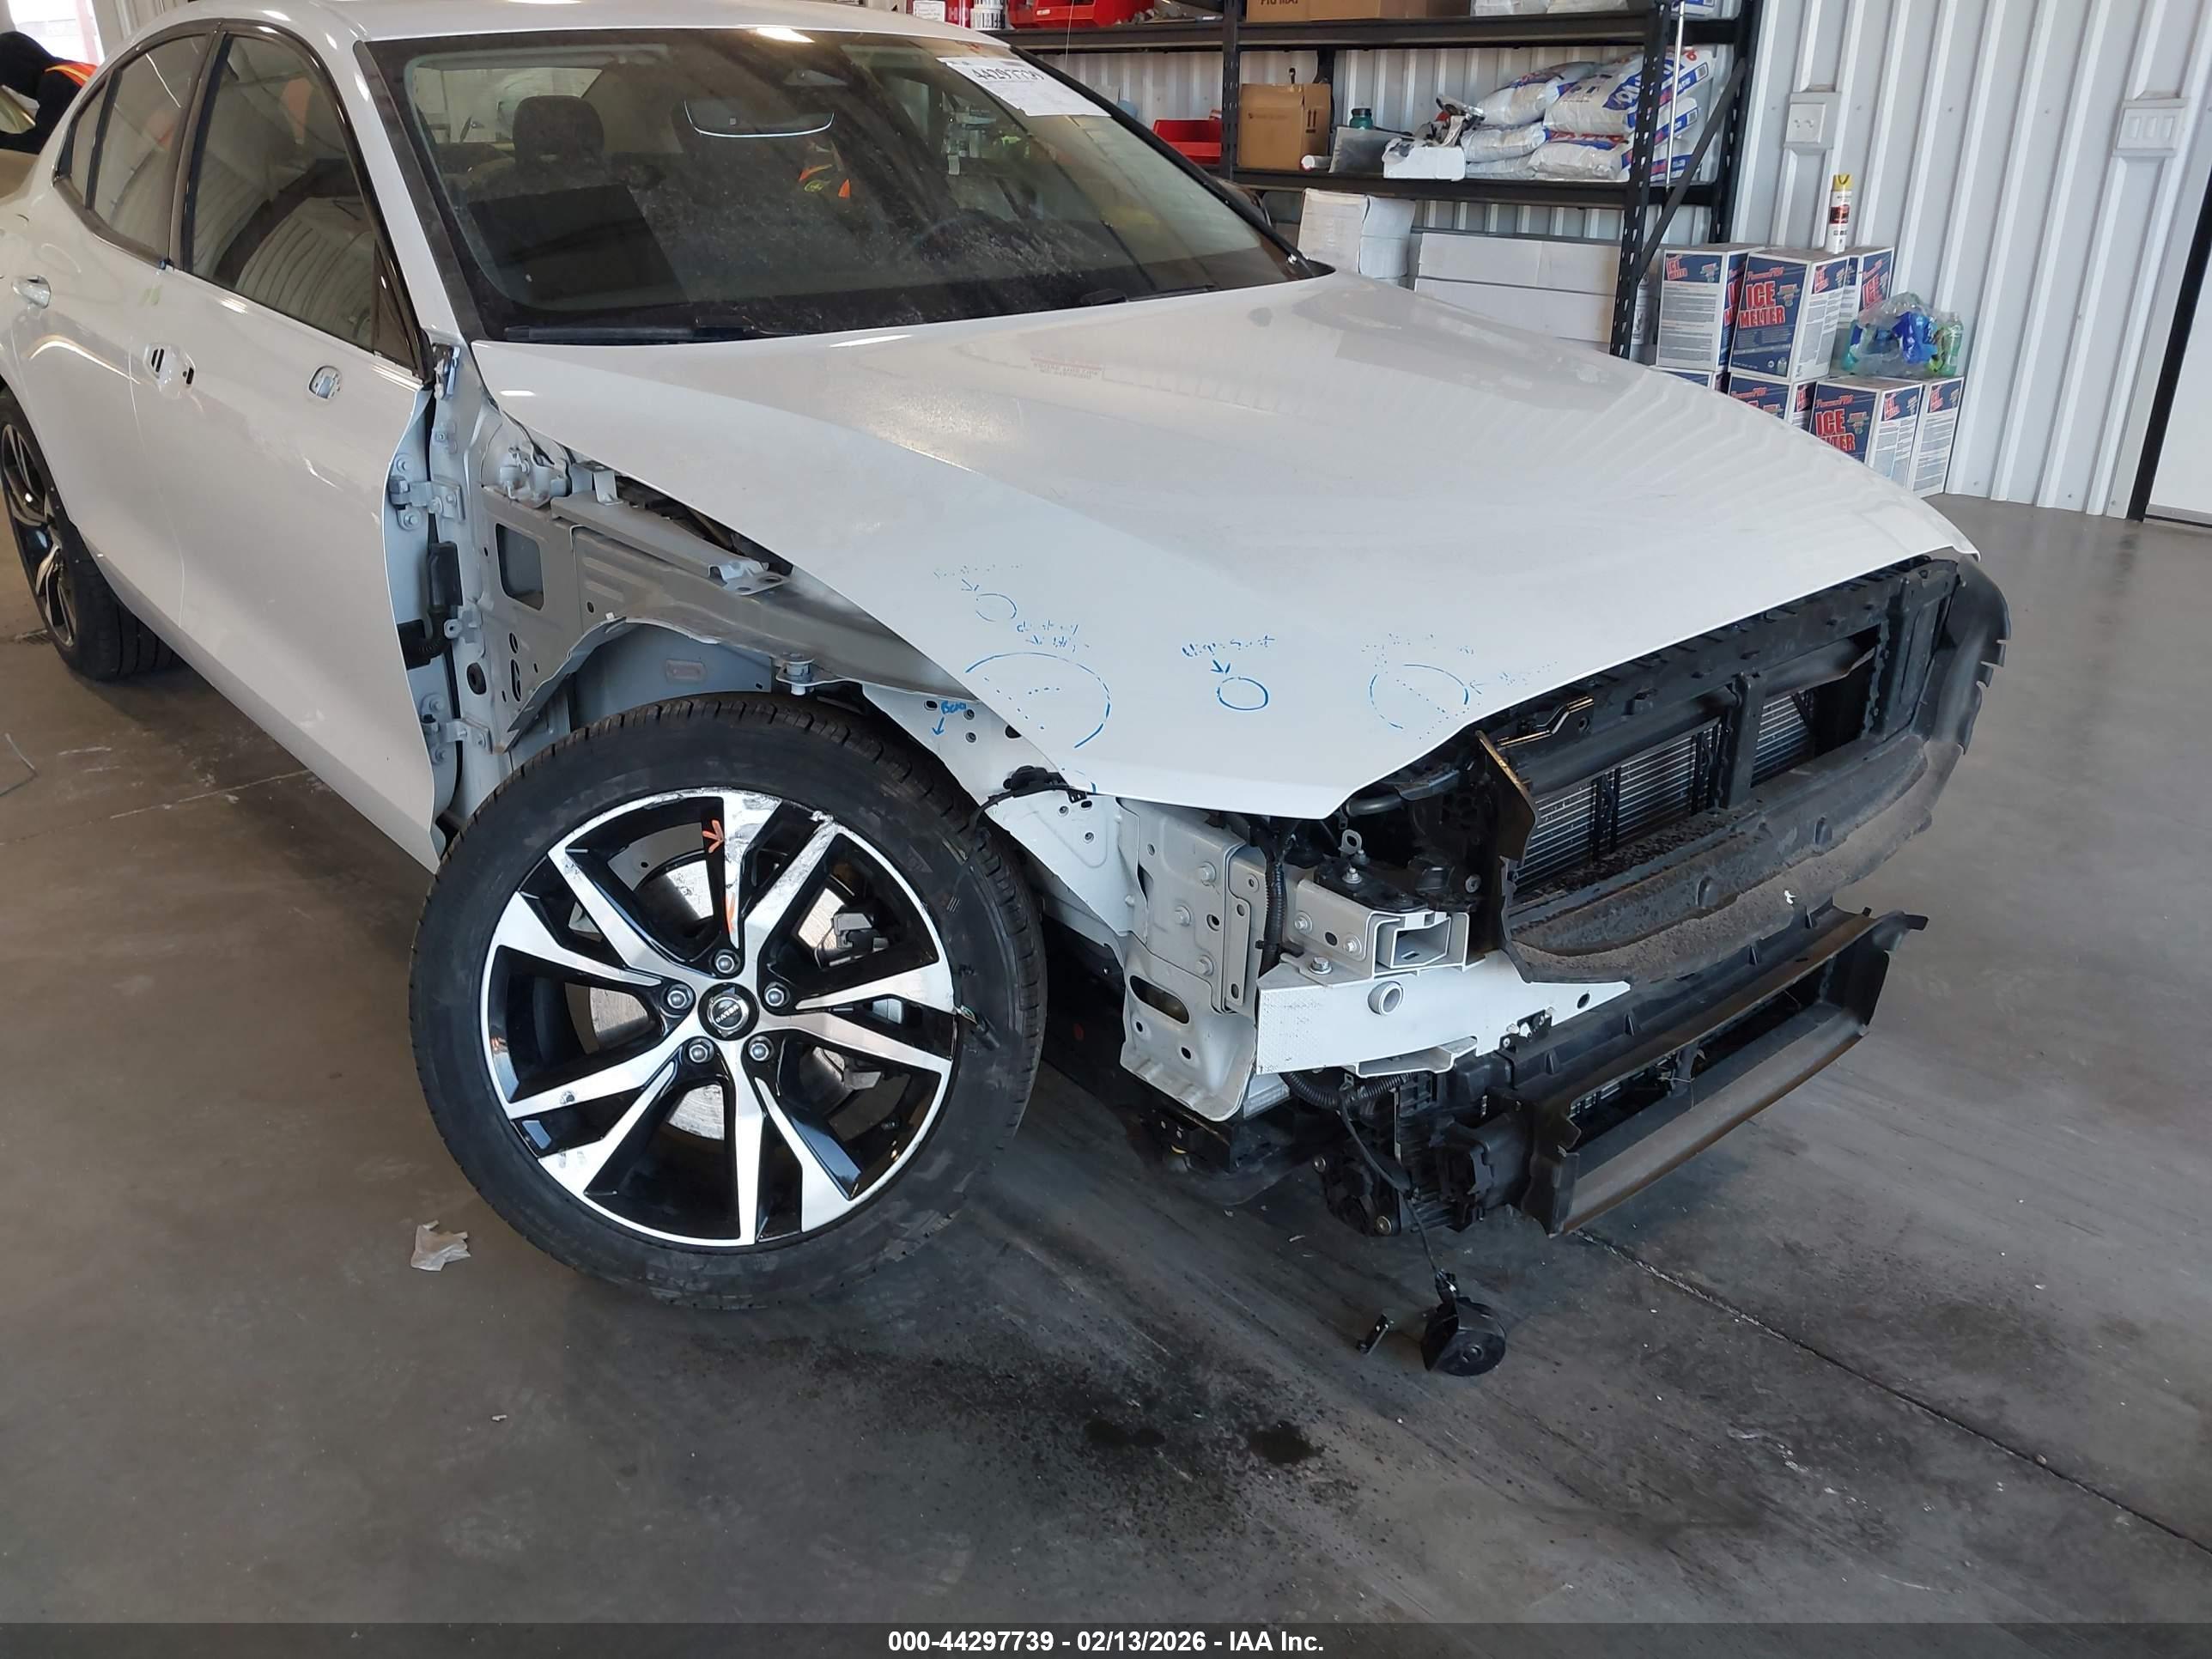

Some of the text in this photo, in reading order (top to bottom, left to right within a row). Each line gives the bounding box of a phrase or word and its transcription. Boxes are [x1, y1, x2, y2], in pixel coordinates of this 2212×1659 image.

[1746, 281, 1777, 309] ICE
[1740, 306, 1786, 328] MELTER
[1815, 409, 1846, 436] ICE
[714, 1003, 740, 1024] VOLVO
